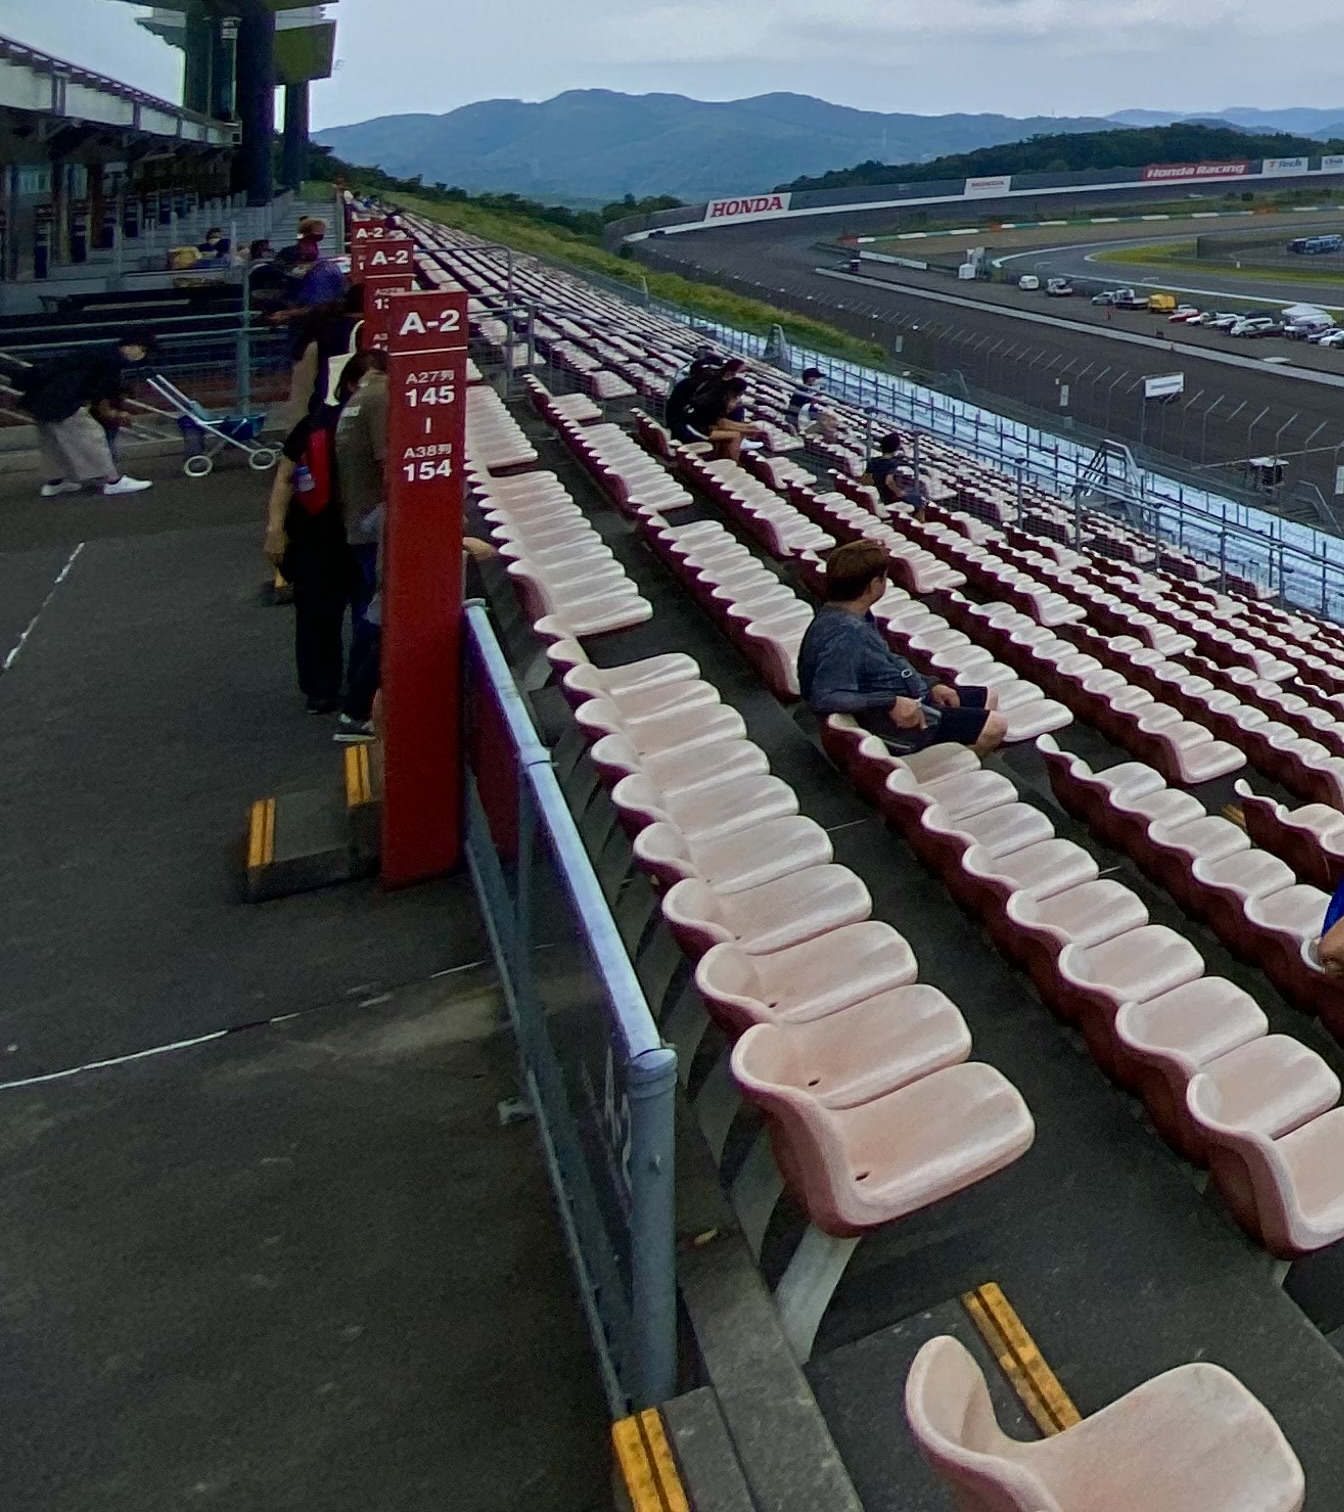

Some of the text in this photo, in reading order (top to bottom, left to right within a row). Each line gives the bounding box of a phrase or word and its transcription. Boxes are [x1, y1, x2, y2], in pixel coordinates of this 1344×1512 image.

[1147, 164, 1245, 178] Honda Racing
[711, 197, 782, 217] HONDA
[356, 227, 383, 238] A-2
[371, 250, 408, 265] A-2
[399, 309, 460, 336] A-2
[404, 386, 455, 407] 145
[402, 460, 452, 482] 154
